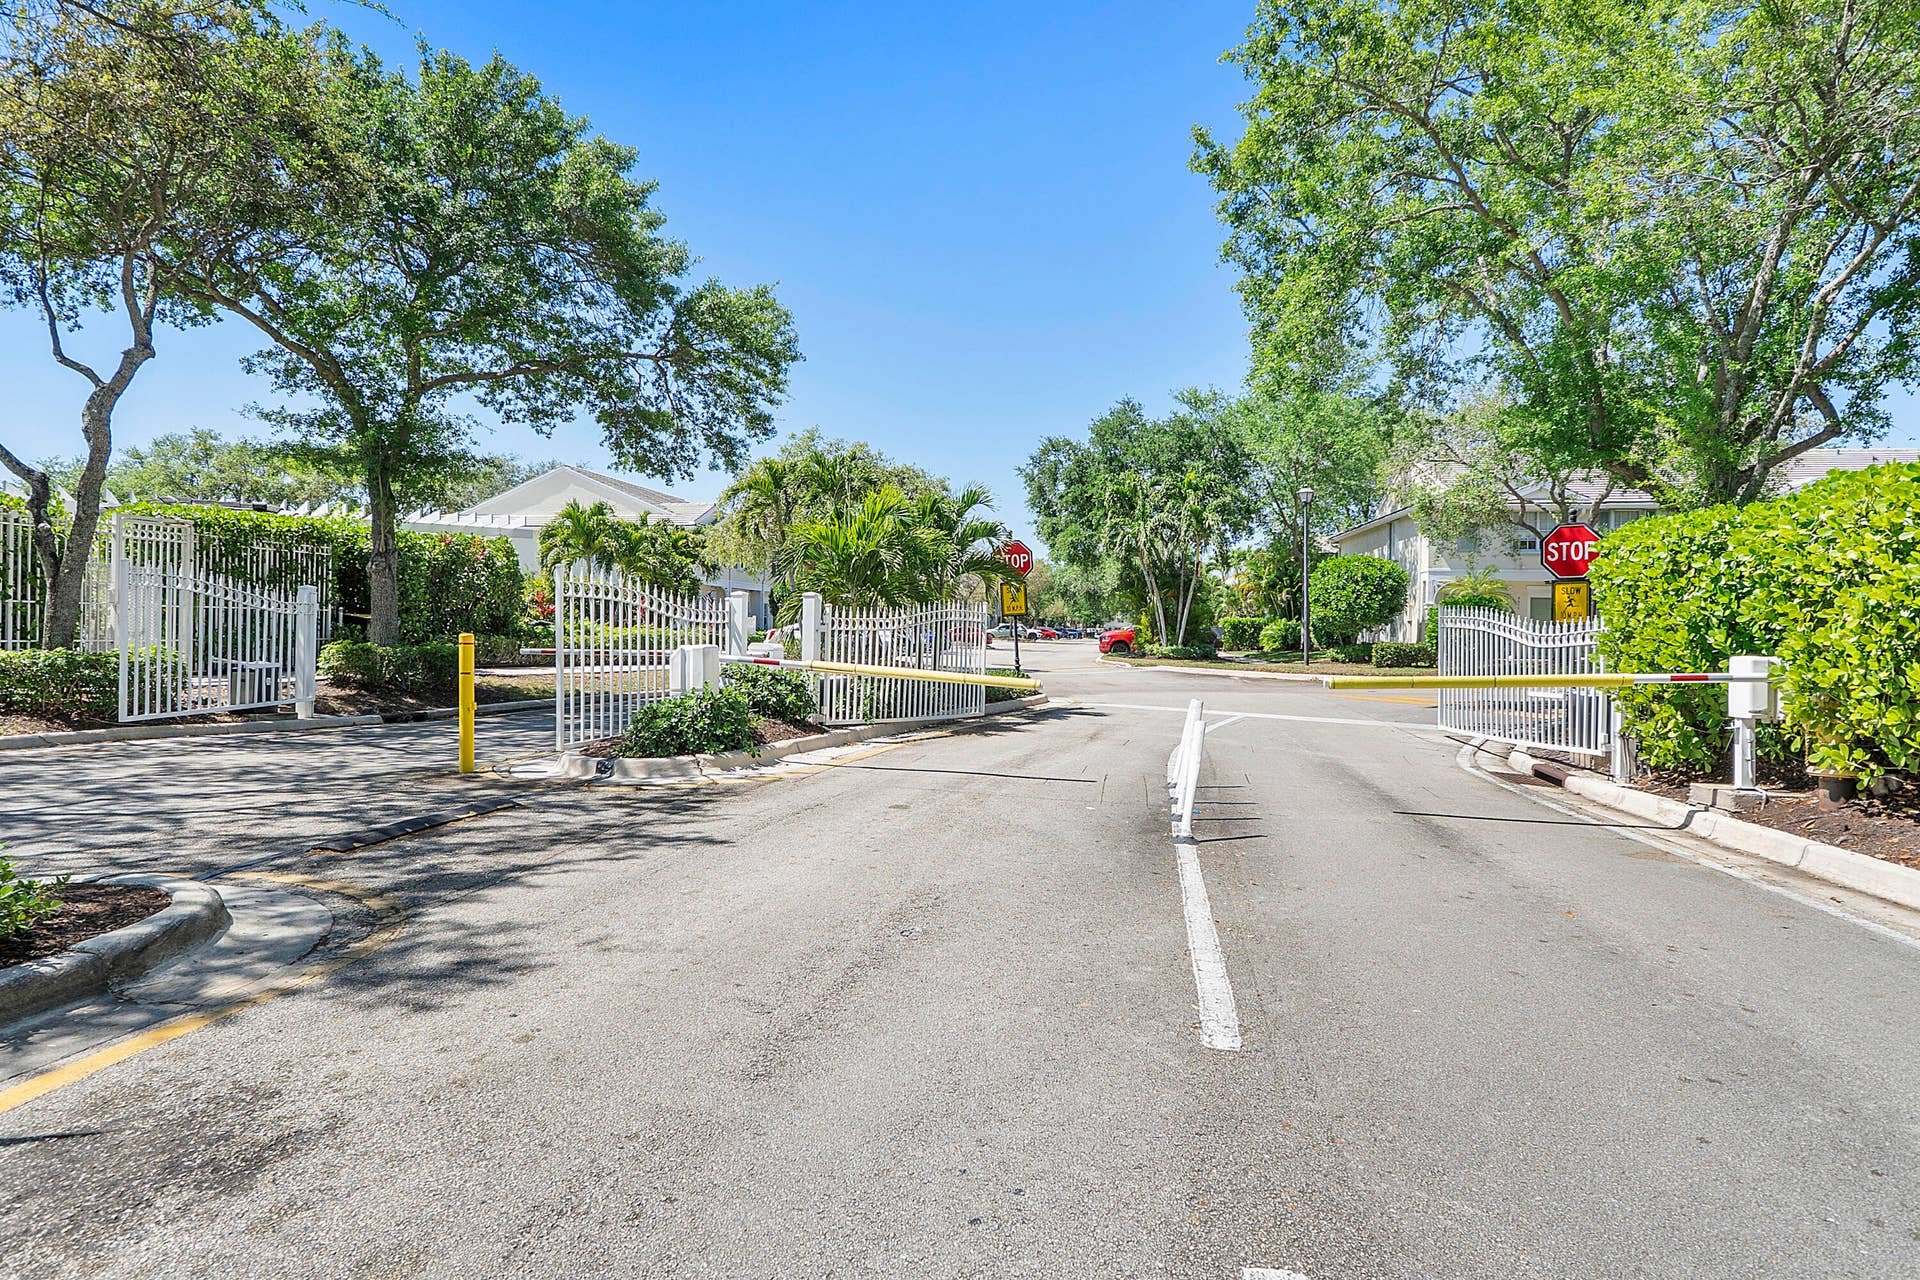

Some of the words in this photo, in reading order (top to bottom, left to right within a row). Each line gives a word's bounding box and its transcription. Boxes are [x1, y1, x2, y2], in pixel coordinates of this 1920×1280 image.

[1547, 541, 1596, 562] STOP
[1000, 553, 1029, 569] TOP
[1561, 586, 1582, 595] SLOW
